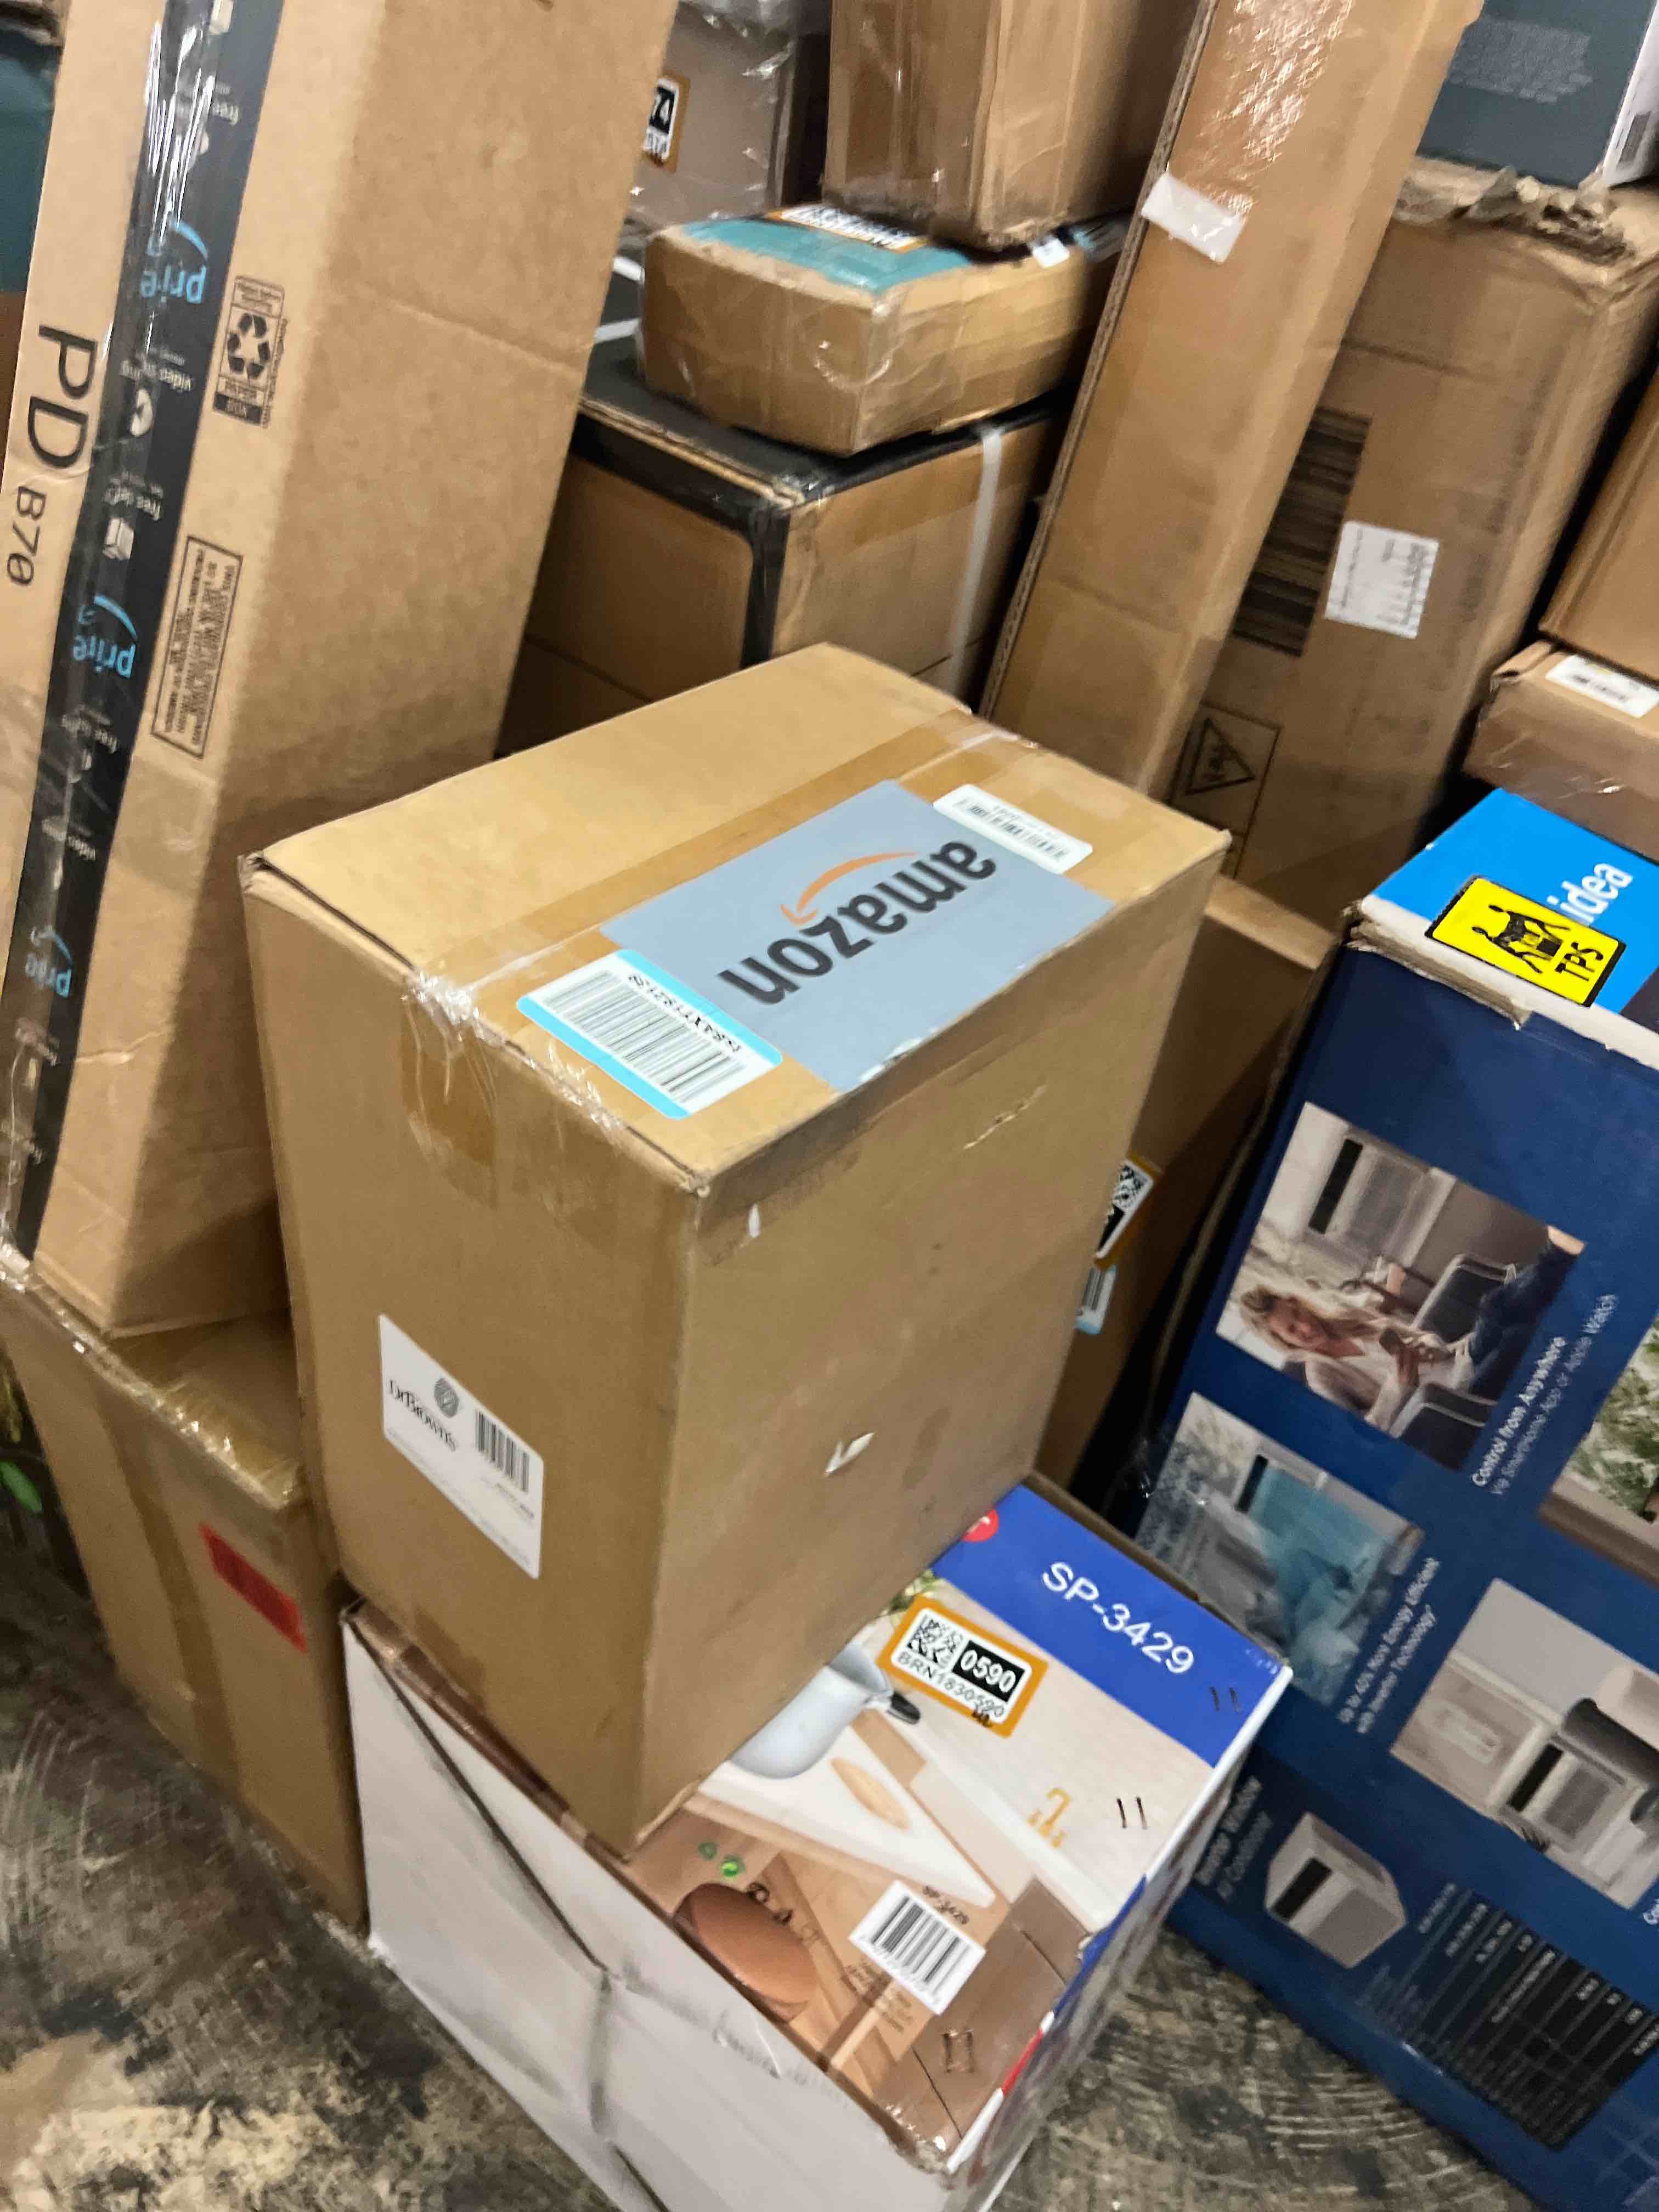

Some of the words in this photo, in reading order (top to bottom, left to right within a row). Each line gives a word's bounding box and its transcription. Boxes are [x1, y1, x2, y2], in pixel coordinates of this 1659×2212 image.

[27, 325, 98, 468] PD
[719, 839, 996, 1004] amazon
[1547, 863, 1633, 923] idea
[1554, 942, 1604, 982] TPS
[1471, 1437, 1508, 1486] Control
[1498, 1406, 1527, 1439] from
[1518, 1336, 1567, 1406] Anywhere
[959, 1649, 1017, 1694] 0590
[1042, 1562, 1194, 1674] SP-3429
